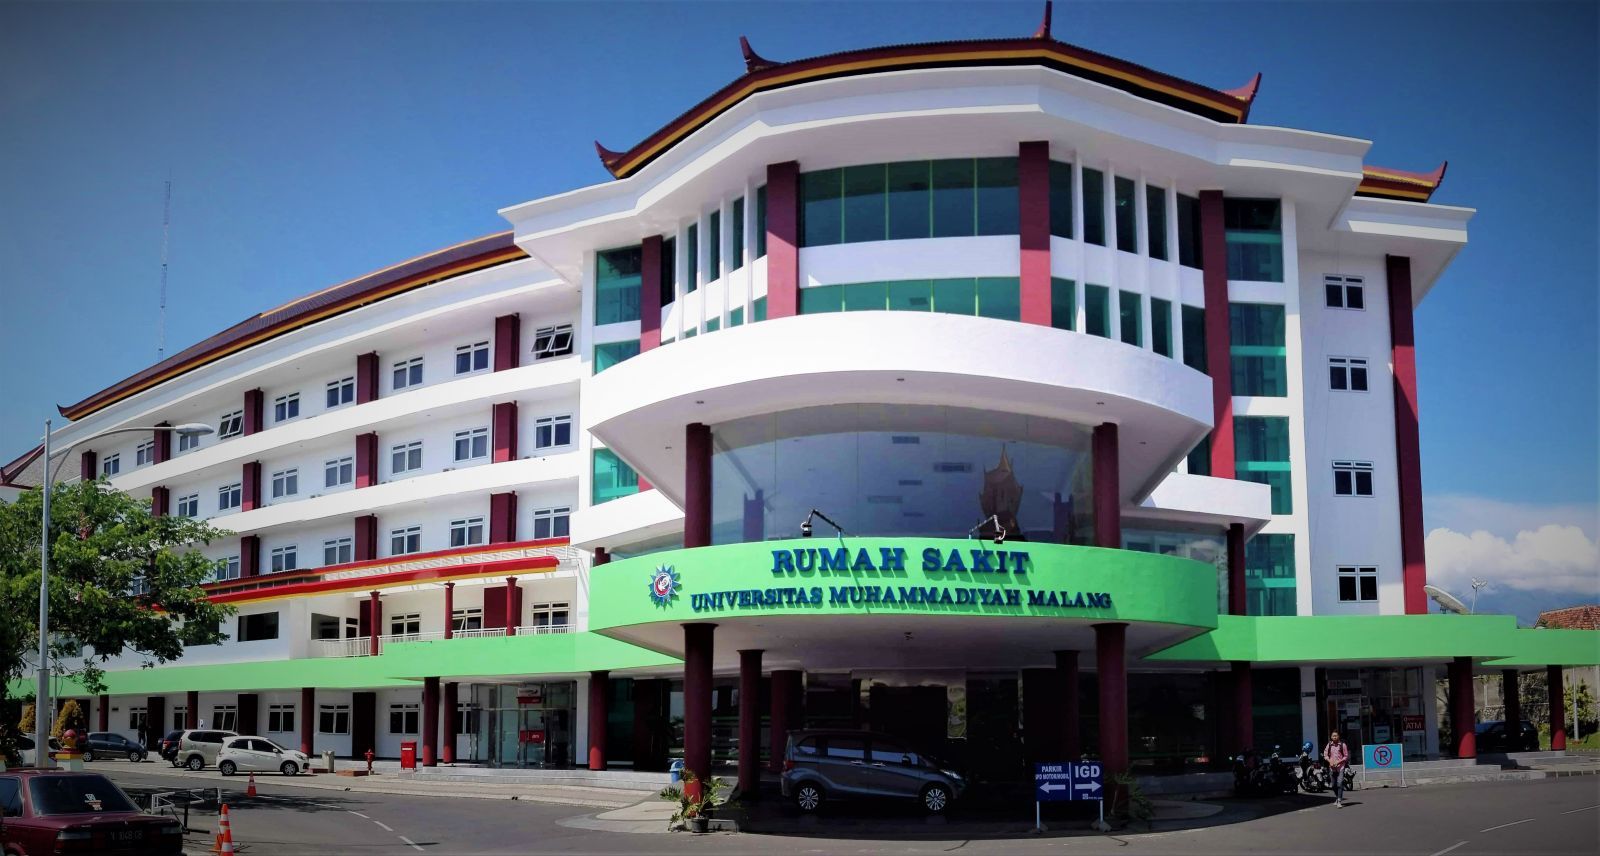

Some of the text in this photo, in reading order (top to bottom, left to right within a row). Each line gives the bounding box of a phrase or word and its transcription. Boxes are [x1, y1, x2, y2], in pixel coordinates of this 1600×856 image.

[771, 547, 1030, 574] RUMAH SAKIT
[690, 586, 1113, 611] UNIVERSITAS MUHAMMADIYAH MALANG
[1406, 721, 1422, 730] ATM
[1074, 765, 1101, 778] IGD
